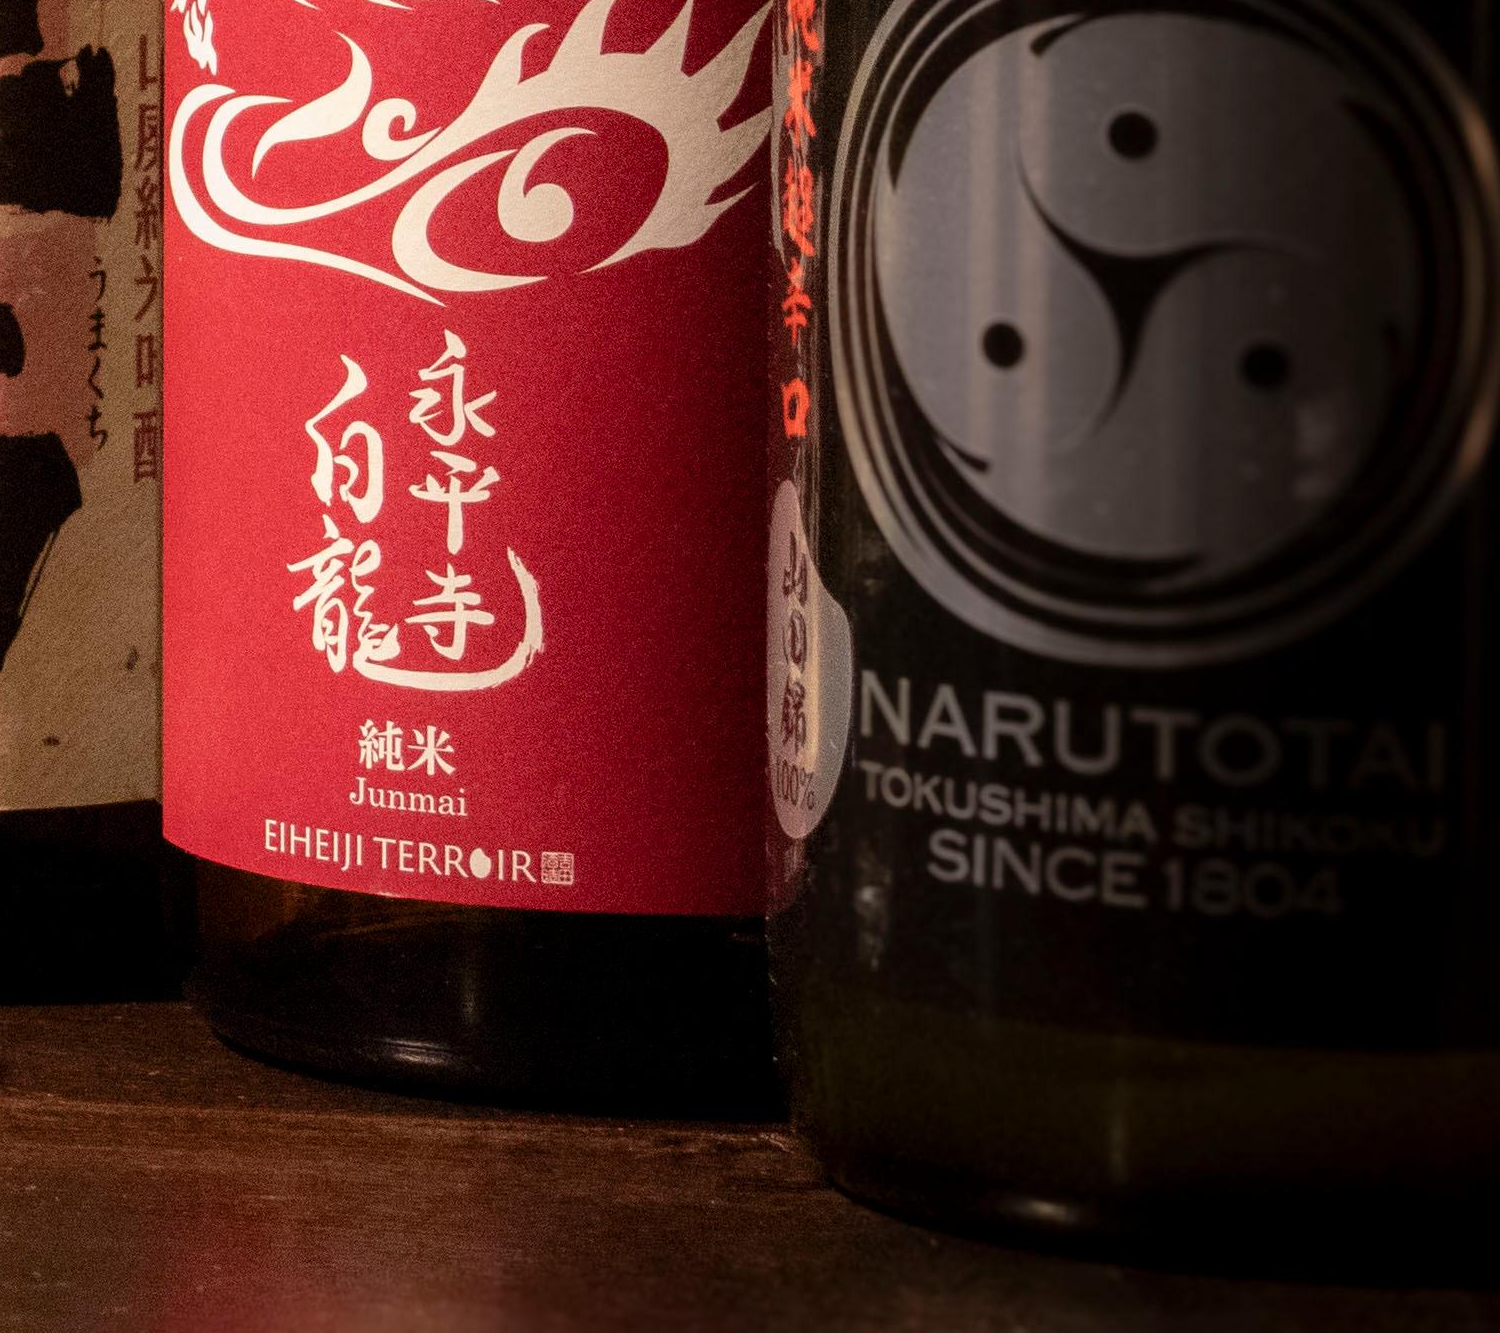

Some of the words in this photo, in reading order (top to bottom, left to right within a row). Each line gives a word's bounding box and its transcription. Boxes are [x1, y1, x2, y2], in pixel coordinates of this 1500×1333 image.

[406, 329, 499, 660] 永平寺
[358, 719, 456, 776] 純米
[860, 669, 1450, 793] NARUTOTAI
[349, 776, 469, 817] Junmai
[776, 754, 816, 811] 100%
[861, 761, 1160, 846] TOKUSHIMA
[1174, 803, 1450, 859] SHIKOKU
[264, 818, 365, 872] EIHEIJI
[927, 831, 1149, 911] SINCE
[1160, 859, 1346, 922] 1804
